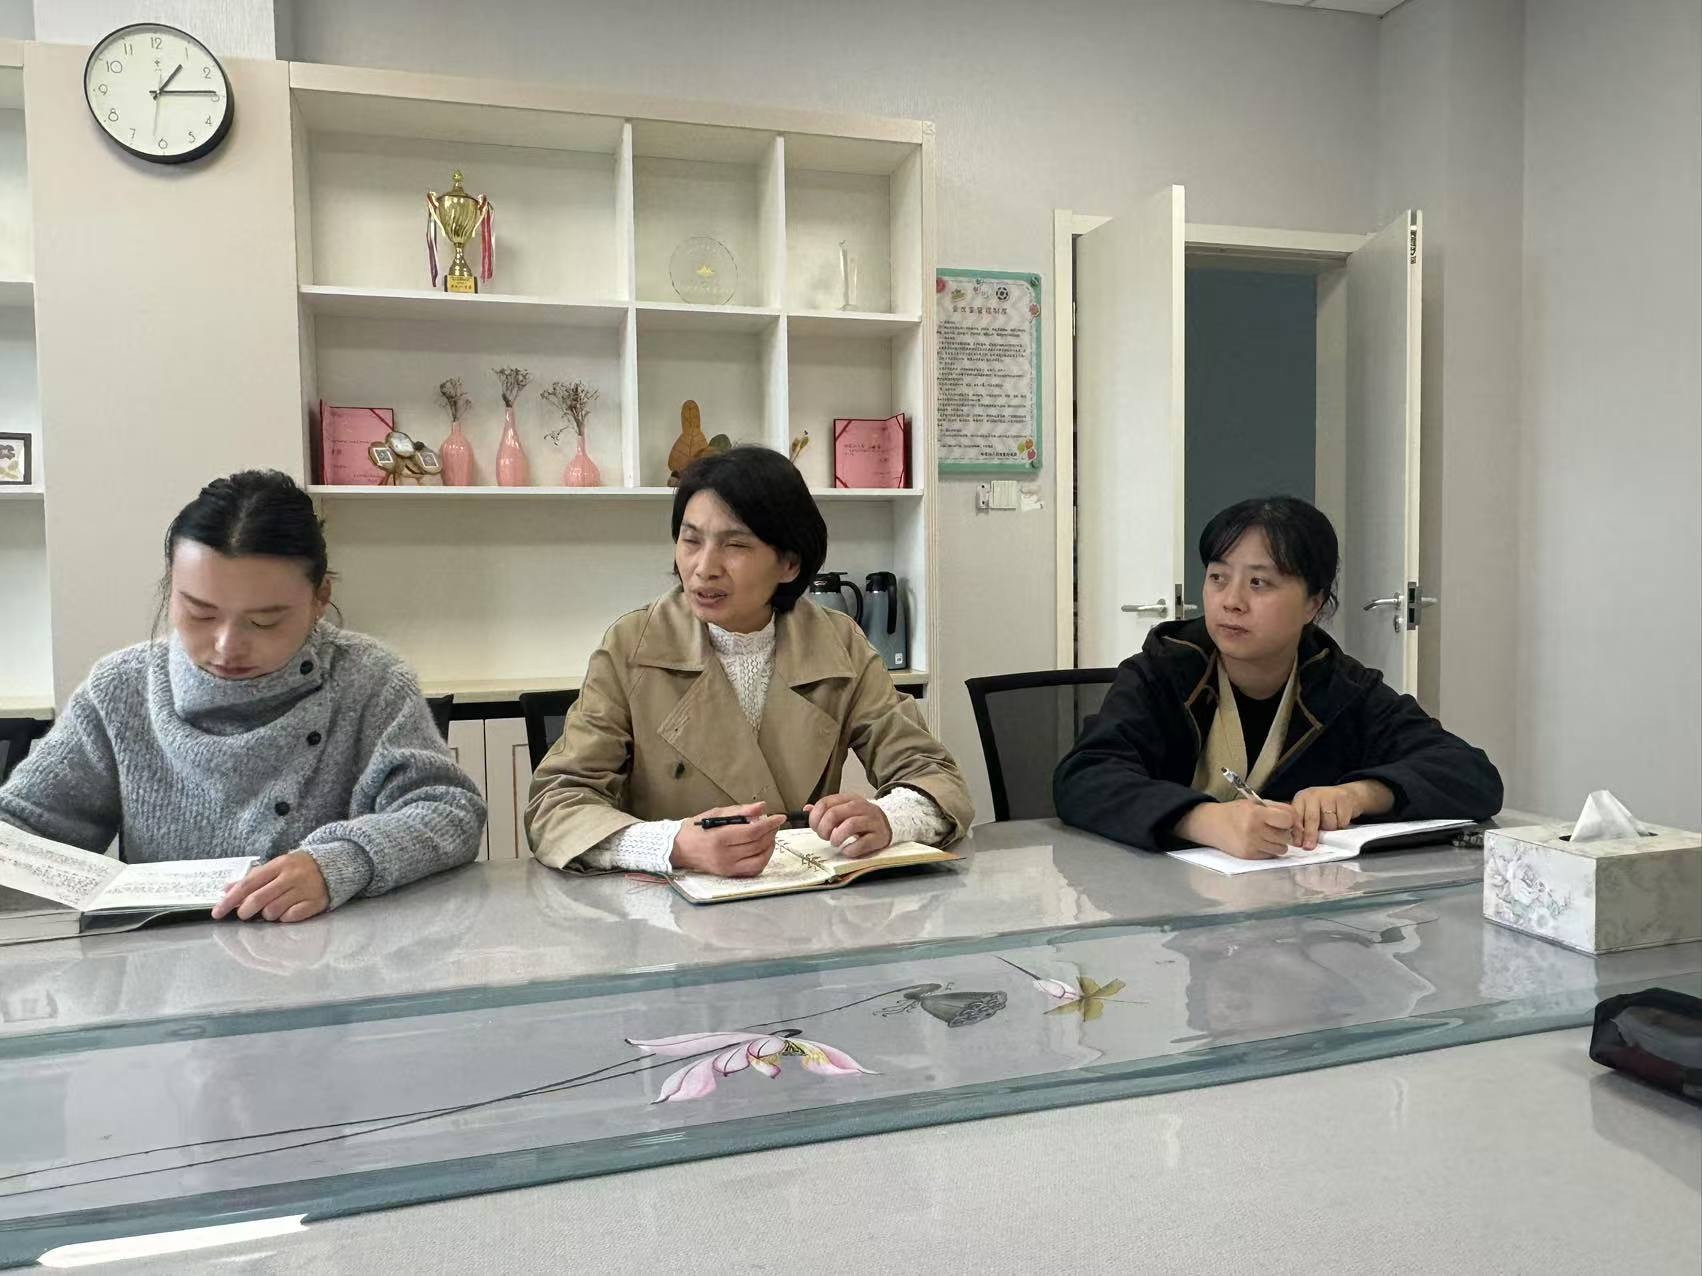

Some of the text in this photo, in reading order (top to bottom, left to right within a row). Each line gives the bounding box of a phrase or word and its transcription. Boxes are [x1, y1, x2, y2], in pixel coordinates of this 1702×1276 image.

[123, 43, 134, 56] 11
[150, 37, 163, 50] 12
[185, 47, 189, 60] 1
[106, 60, 123, 74] 10
[203, 67, 211, 79] 2
[98, 84, 108, 96] 9
[107, 108, 119, 122] 8
[205, 115, 213, 126] 4
[129, 127, 136, 139] 7
[187, 131, 196, 144] 5
[158, 138, 168, 149] 6
